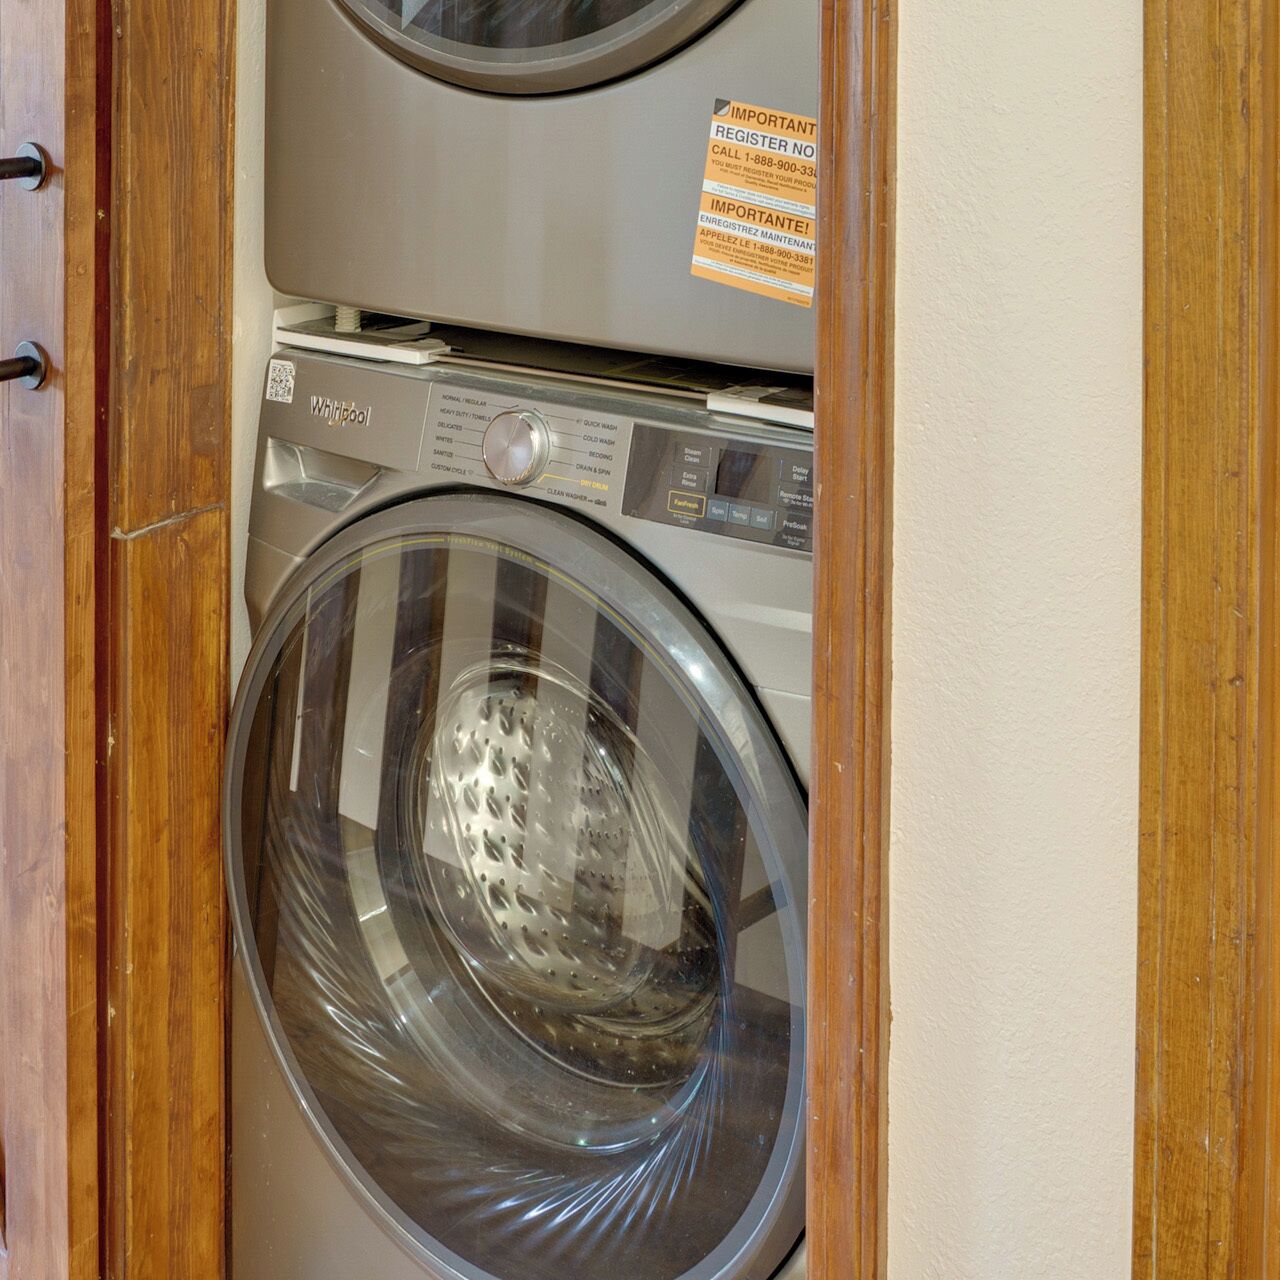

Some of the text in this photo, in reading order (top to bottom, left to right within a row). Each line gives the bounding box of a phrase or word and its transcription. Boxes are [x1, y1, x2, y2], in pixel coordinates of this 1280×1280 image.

[731, 106, 816, 135] IMPORTANT
[715, 125, 815, 158] REGISTER NO
[712, 144, 816, 178] CALL 1-888-900-33
[712, 159, 816, 189] YOU MUST REGISTER YOUR PRODU
[710, 198, 809, 235] IMPORTANTE!
[700, 214, 816, 252] ENREGISTREZ MAINTENANT
[700, 228, 738, 246] APPELEZ
[740, 239, 750, 249] LE
[752, 242, 813, 265] 1-888-900-3381
[310, 395, 372, 427] Whirlpool
[583, 419, 618, 431] QUICK WASH
[582, 434, 616, 446] COLD WASH
[589, 451, 613, 461] BEDDING
[575, 463, 593, 472] DRAIN
[598, 468, 611, 476] SPIN
[682, 471, 697, 480] Extra
[792, 465, 809, 475] Delay
[792, 473, 808, 482] Start
[547, 487, 587, 501] CLEAN WASHER
[780, 490, 801, 501] Remote
[782, 520, 808, 530] PreSoak
